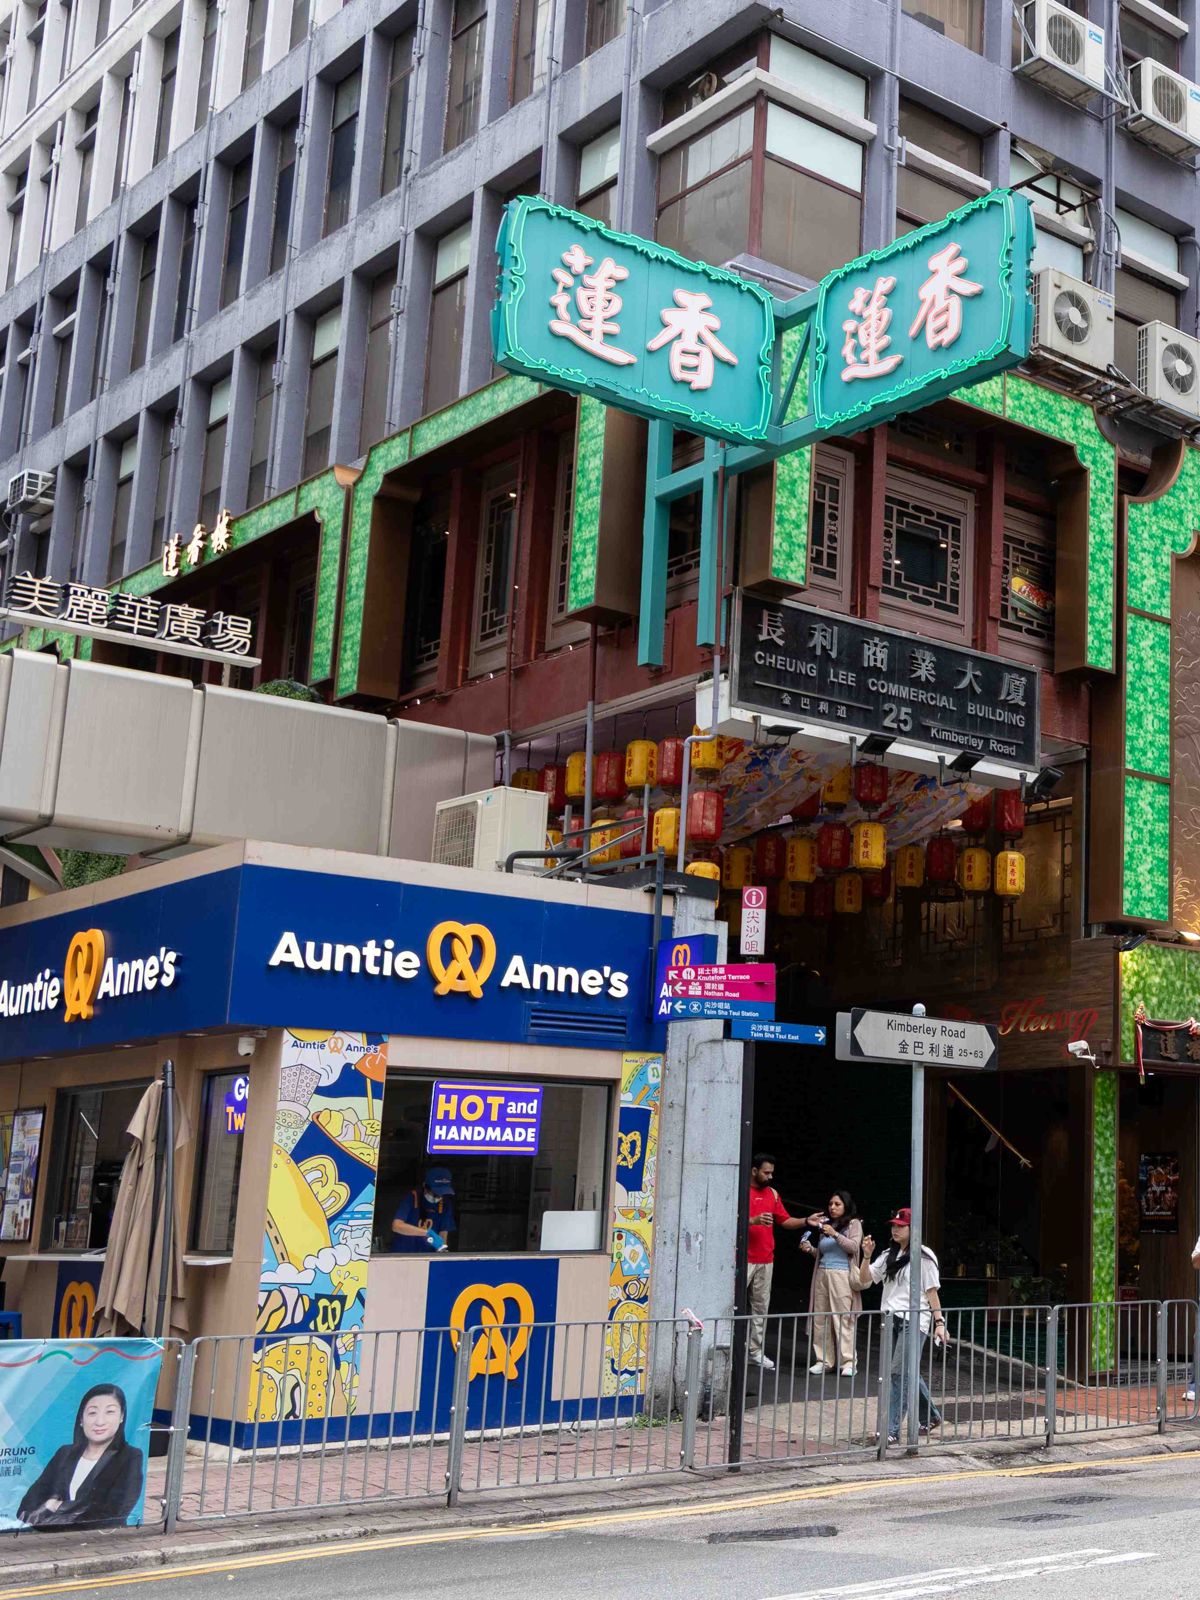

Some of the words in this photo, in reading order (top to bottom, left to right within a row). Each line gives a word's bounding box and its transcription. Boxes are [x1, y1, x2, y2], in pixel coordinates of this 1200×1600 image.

[549, 243, 738, 391] 蓮香
[841, 242, 984, 383] 蓮香
[162, 508, 234, 577] 蓮香樓
[5, 571, 253, 656] 美麗華廣場
[757, 608, 1028, 707] 長利商業大廈
[755, 651, 817, 678] CHEUNG
[829, 667, 857, 687] LEE
[868, 677, 957, 711] COMMERCIAL
[967, 702, 1026, 728] BUILDING
[780, 692, 848, 718] 金巴利道
[883, 702, 913, 732] 25
[930, 726, 984, 751] Kimberley
[989, 739, 1017, 757] Road
[744, 910, 760, 953] 尖沙咀
[268, 931, 420, 980] Auntie
[500, 955, 629, 998] Anne's
[0, 968, 60, 1017] Auntie
[100, 947, 176, 999] Anne's
[704, 990, 724, 998] Nathan
[704, 1002, 731, 1010] 尖沙咀站
[741, 1010, 759, 1018] Station
[751, 1024, 781, 1033] 尖沙咀東部
[887, 1019, 937, 1039] Kimberley
[940, 1022, 966, 1039] Road
[291, 1040, 326, 1050] Auntie
[345, 1044, 379, 1053] Anne's
[898, 1040, 954, 1059] 金巴利道
[435, 1093, 503, 1122] HOT
[506, 1099, 538, 1116] and
[433, 1123, 536, 1143] HANDMADE
